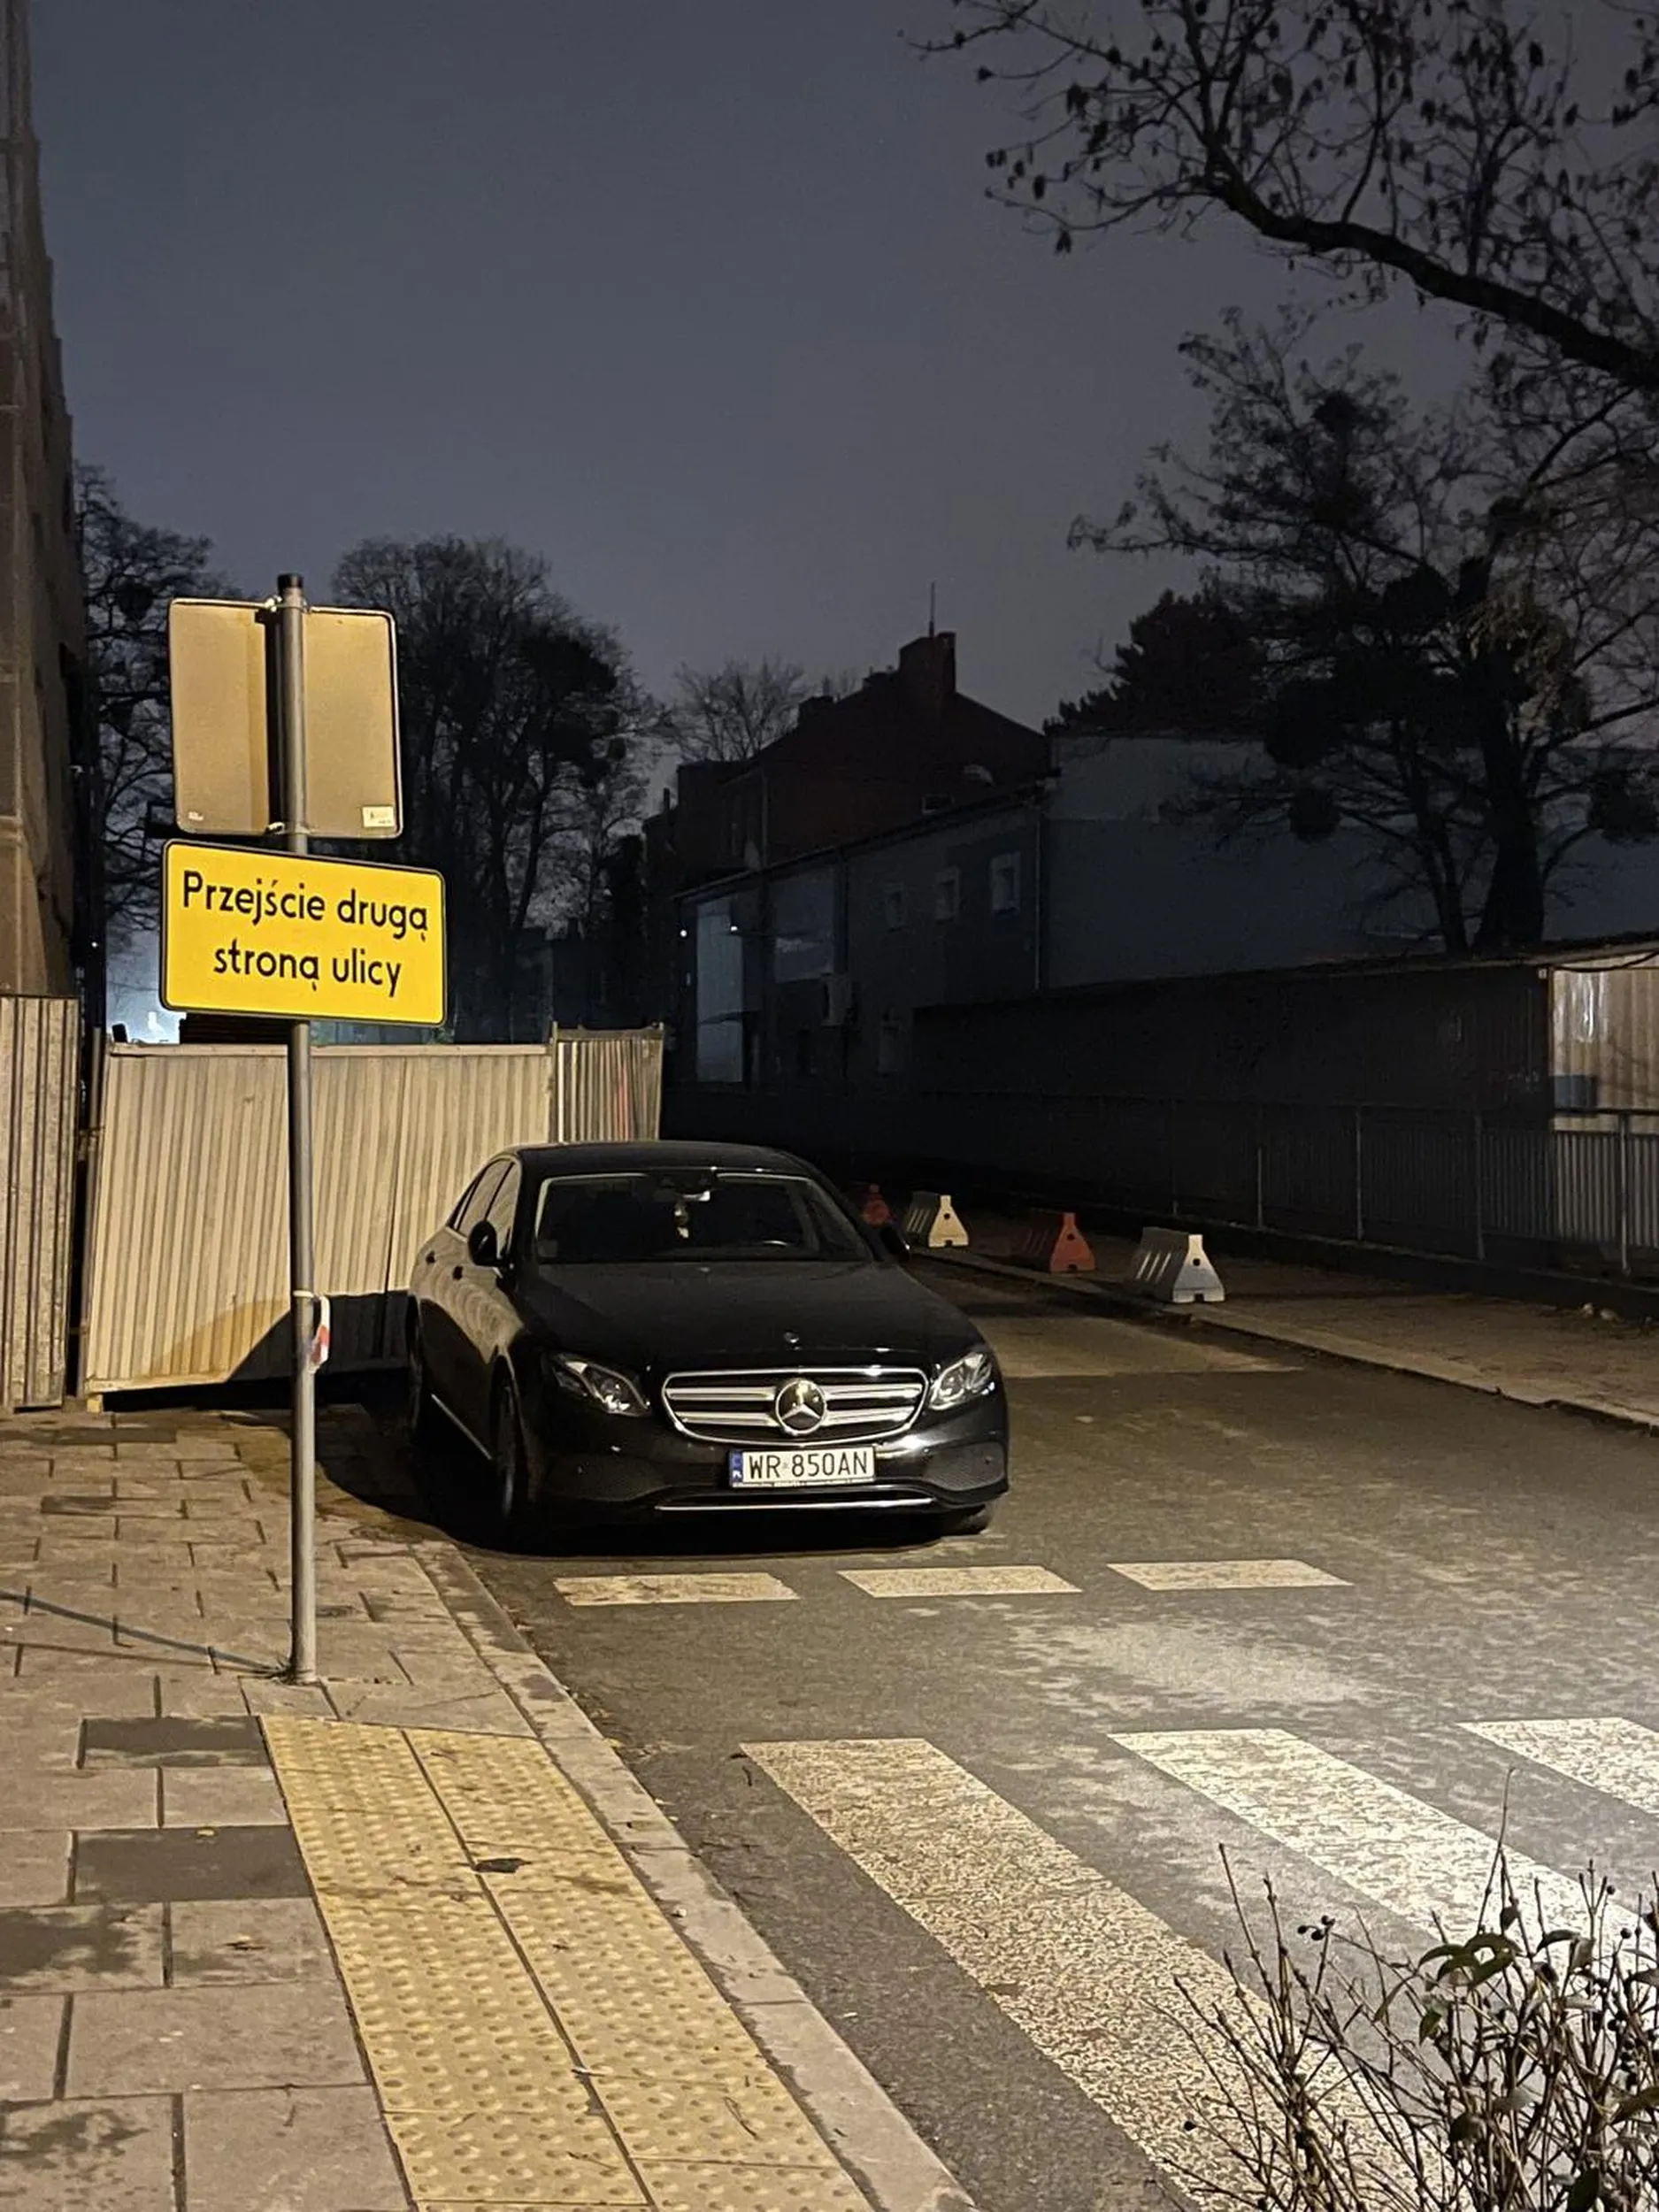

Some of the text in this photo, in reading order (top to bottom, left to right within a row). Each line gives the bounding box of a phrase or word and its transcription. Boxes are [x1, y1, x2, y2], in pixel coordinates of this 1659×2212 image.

[183, 870, 428, 942] Przejście drugą
[213, 938, 402, 997] stroną ulicy
[749, 1451, 868, 1479] WR 850AN
